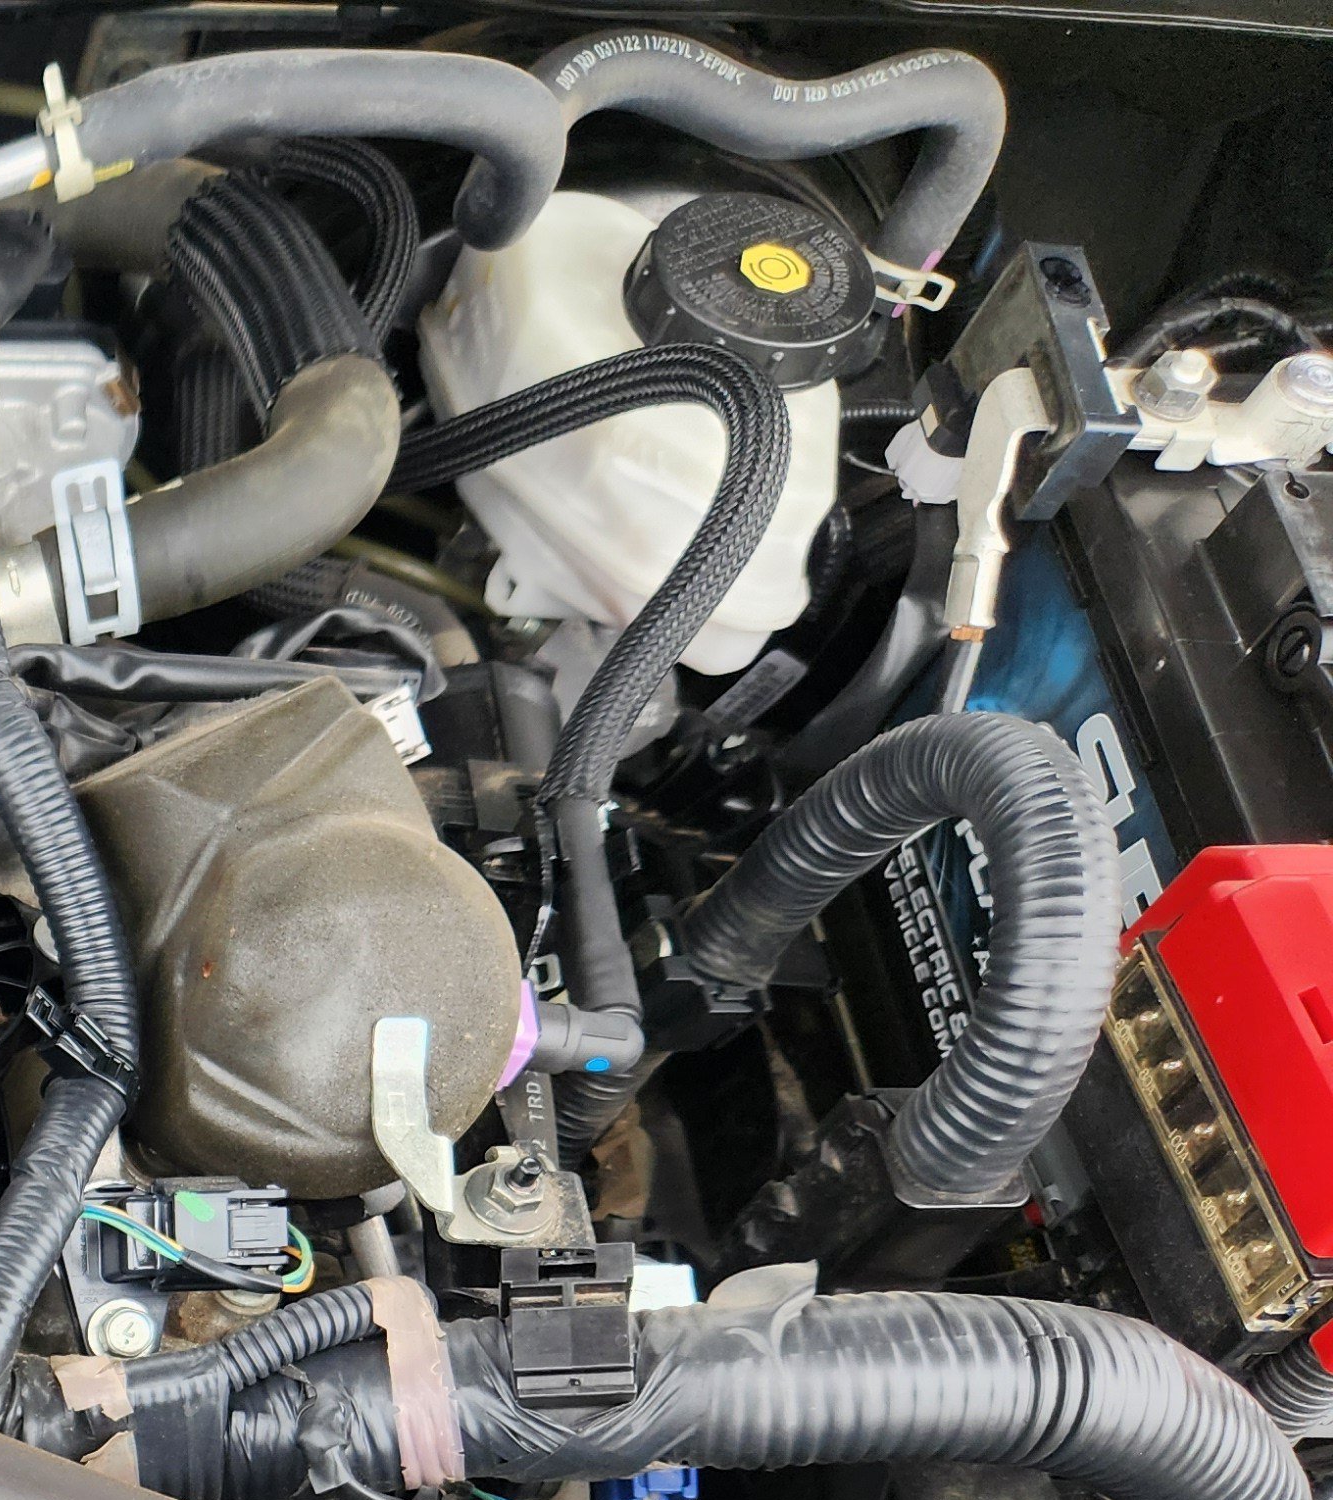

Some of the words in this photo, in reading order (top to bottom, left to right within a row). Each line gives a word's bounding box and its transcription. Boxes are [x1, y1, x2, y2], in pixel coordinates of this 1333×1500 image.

[593, 35, 641, 60] 031122
[831, 69, 888, 98] 031122
[884, 858, 931, 984] VEHICLE
[897, 847, 961, 1008] ELECTRIC
[525, 1081, 545, 1123] TRD
[1167, 1127, 1190, 1165] 100A
